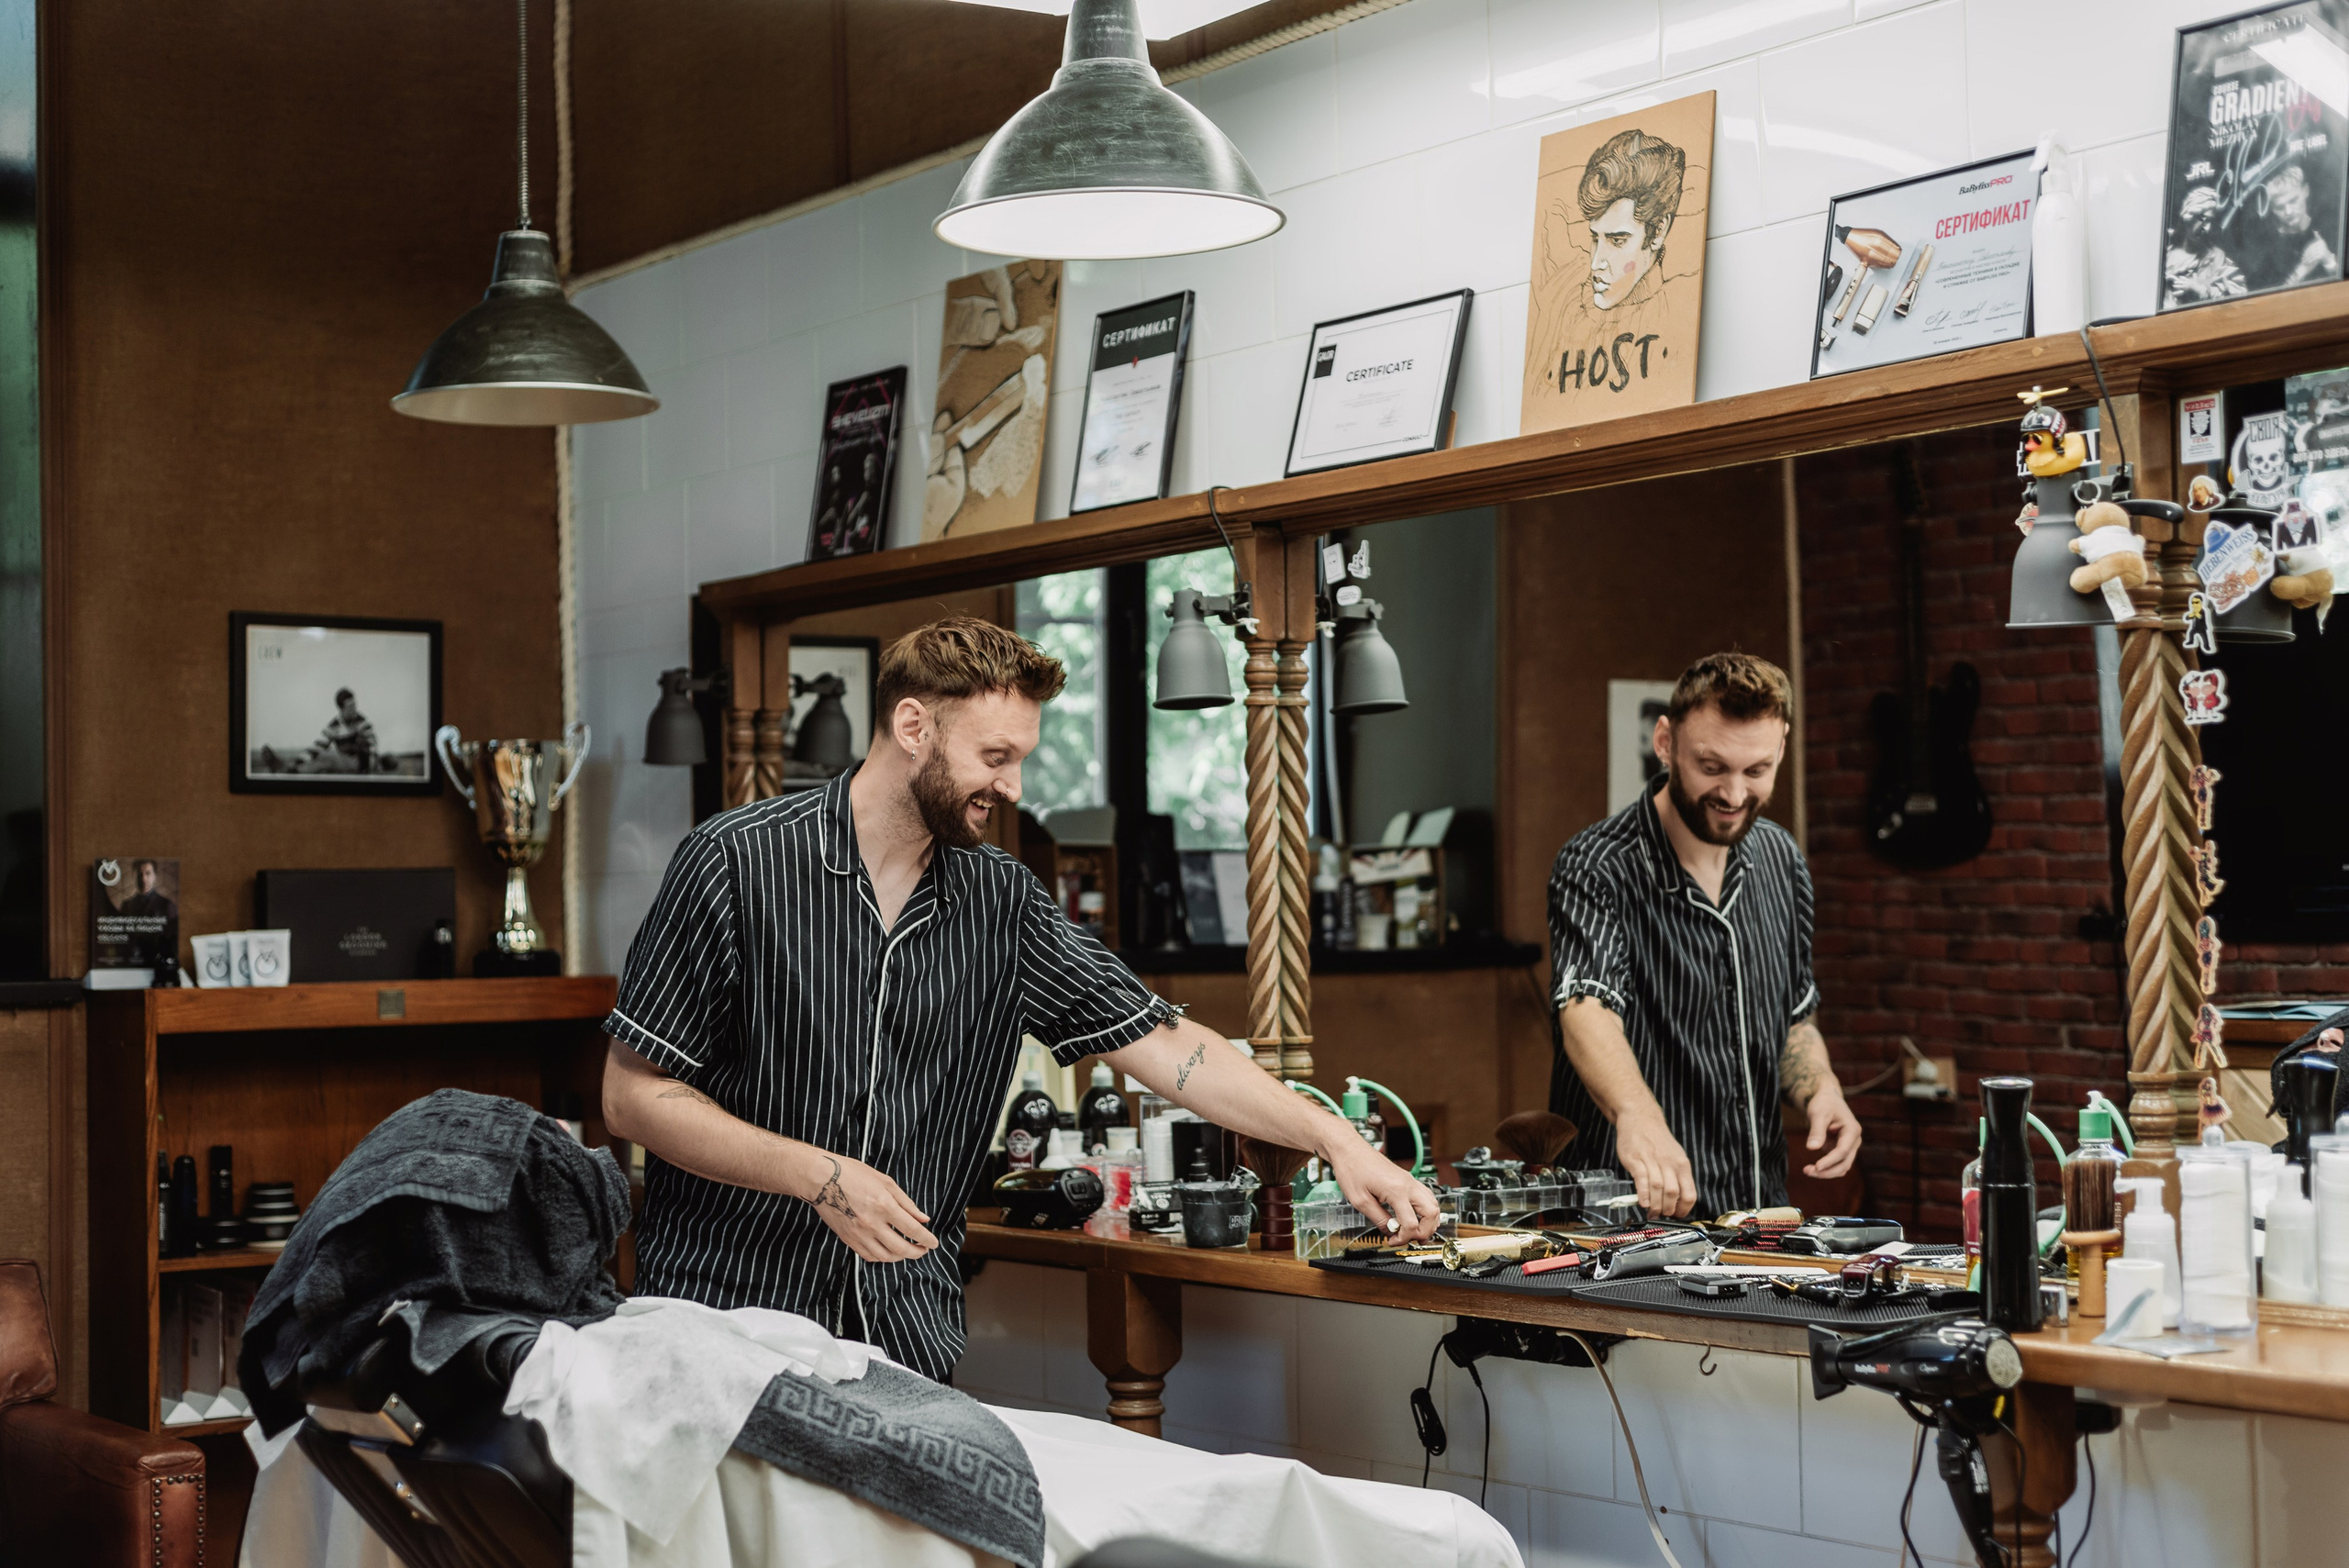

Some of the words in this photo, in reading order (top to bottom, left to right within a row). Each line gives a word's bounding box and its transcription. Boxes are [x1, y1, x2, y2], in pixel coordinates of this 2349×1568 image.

[1935, 199, 2032, 239] СЕРТИФИКАТ
[1102, 317, 1177, 349] СЕРТИФИКАТ
[1346, 359, 1414, 383] CERTIFICATE
[1558, 332, 1660, 394] HOST
[1176, 1042, 1206, 1091] always
